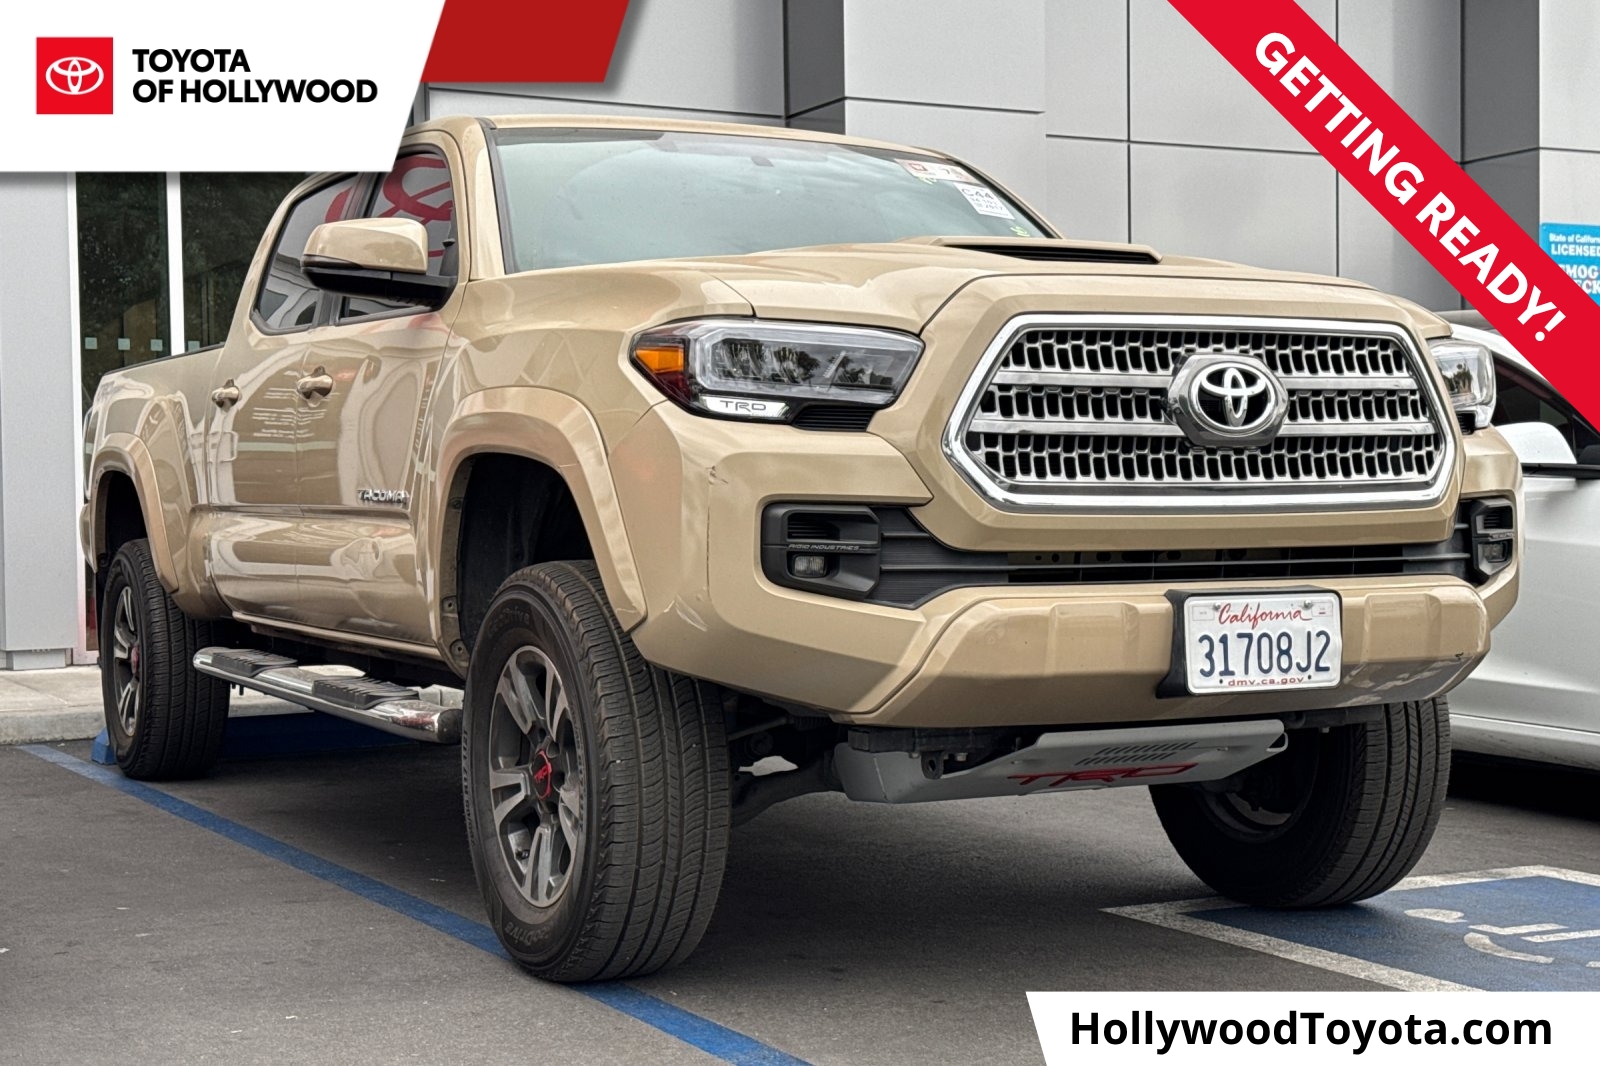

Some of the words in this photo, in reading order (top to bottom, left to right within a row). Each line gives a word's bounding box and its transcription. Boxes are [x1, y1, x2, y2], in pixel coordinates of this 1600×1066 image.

[720, 400, 766, 412] TRD
[357, 489, 410, 503] TACOMA
[1218, 602, 1313, 630] California
[1198, 630, 1331, 678] 31708J2
[1228, 676, 1304, 687] dmv.ca.gov
[1007, 762, 1199, 786] TRD
